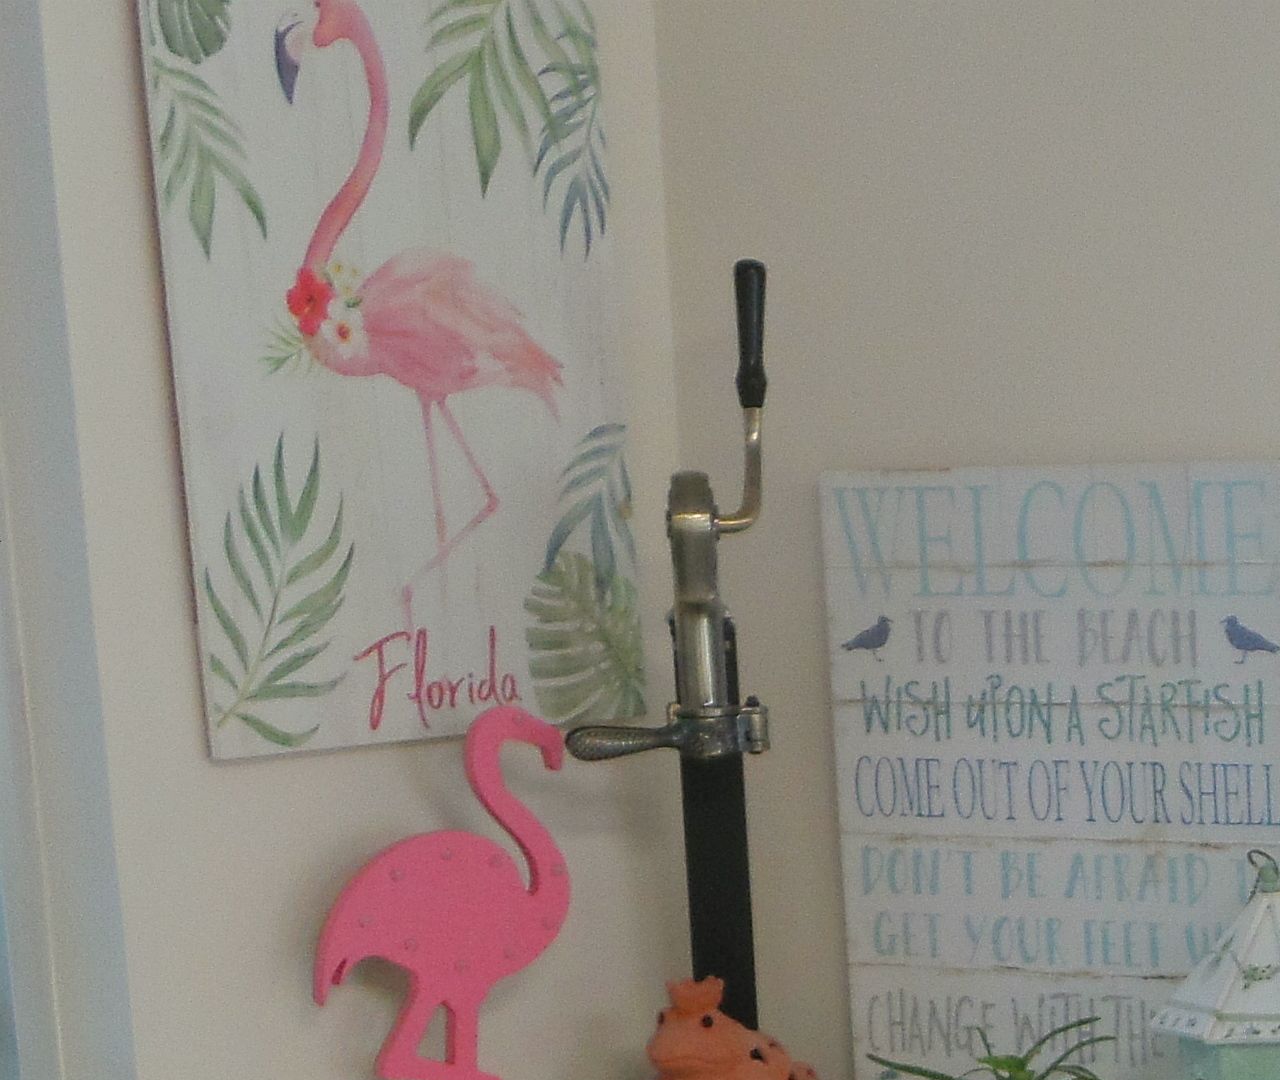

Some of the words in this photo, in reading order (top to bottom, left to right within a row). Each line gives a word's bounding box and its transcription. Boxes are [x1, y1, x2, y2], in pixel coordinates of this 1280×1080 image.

[909, 608, 951, 664] TO
[982, 608, 1050, 665] THE
[1076, 607, 1199, 667] BEACH
[353, 625, 522, 731] Florida
[859, 675, 952, 742] WISH
[1067, 685, 1086, 747] A
[1095, 674, 1265, 747] STARFISH
[854, 755, 946, 819] COME
[953, 757, 1019, 821] OUT
[1028, 758, 1069, 822] OF
[1079, 760, 1172, 825] YOUR
[861, 844, 977, 897] DON'T
[1000, 848, 1043, 900] BE
[1065, 850, 1210, 905] AFRAID
[872, 910, 945, 959] GET
[964, 911, 1063, 966] YOUR
[1082, 918, 1164, 968] FEET
[867, 988, 997, 1057] CHANGE
[1011, 993, 1096, 1064] WITH
